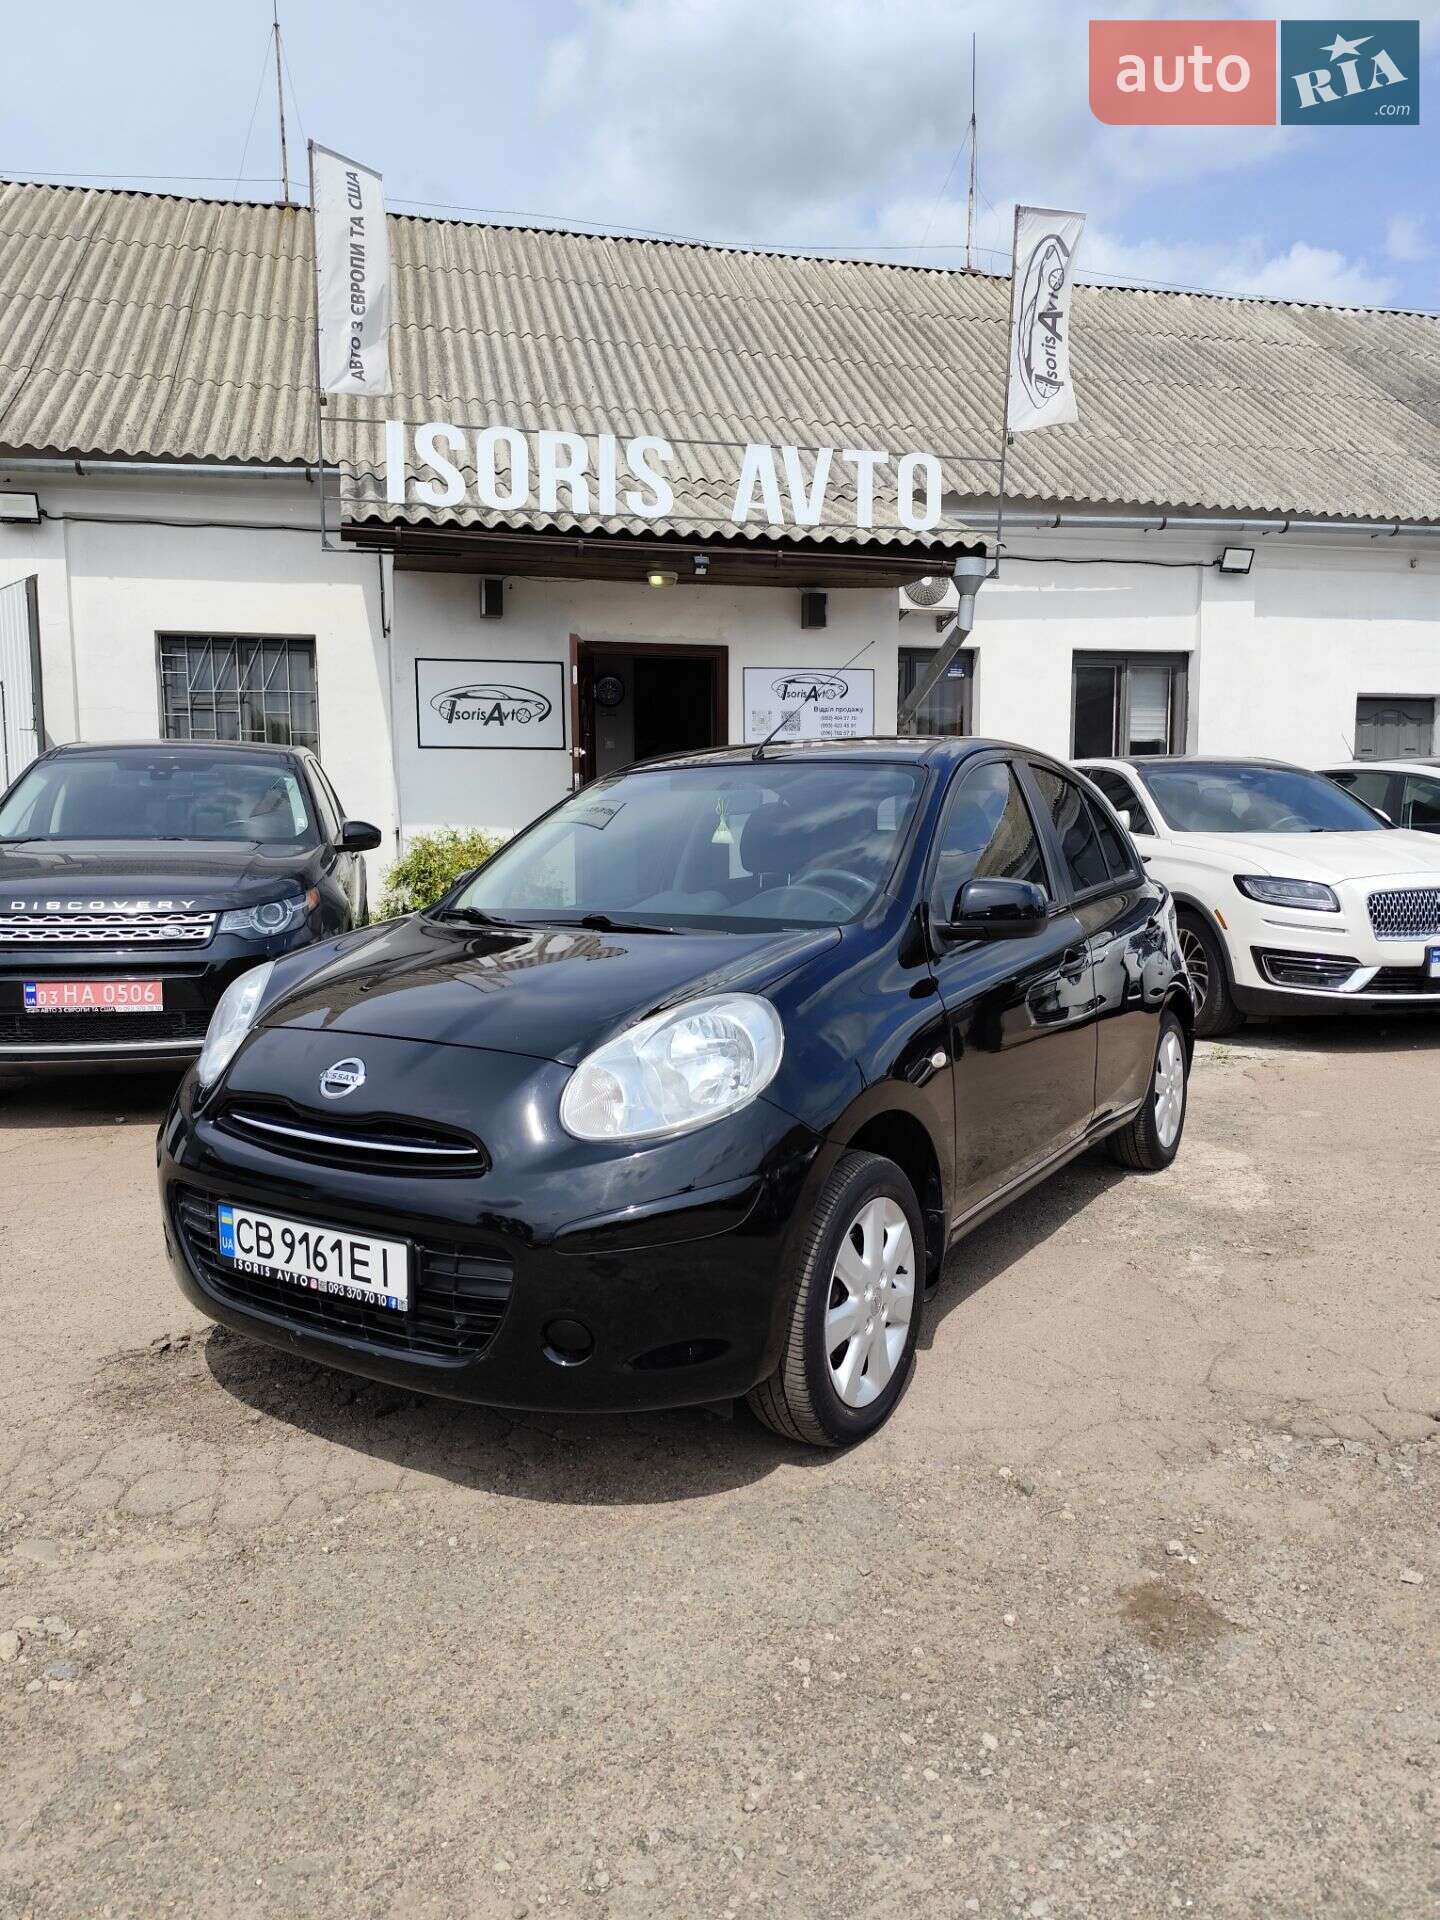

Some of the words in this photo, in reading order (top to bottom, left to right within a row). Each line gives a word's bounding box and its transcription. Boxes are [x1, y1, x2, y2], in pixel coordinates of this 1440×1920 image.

[346, 172, 363, 211] США
[350, 216, 365, 240] ТА
[350, 243, 366, 316] ЄВРОПИ
[385, 419, 675, 519] ISORIS
[731, 443, 942, 531] AVTO
[10, 900, 196, 911] DISCOVERY
[38, 991, 58, 1005] 03
[63, 985, 95, 1004] HA
[103, 984, 156, 1003] 0506
[222, 1236, 234, 1250] UA
[233, 1258, 271, 1278] ISORIS
[276, 1272, 309, 1287] AVTO
